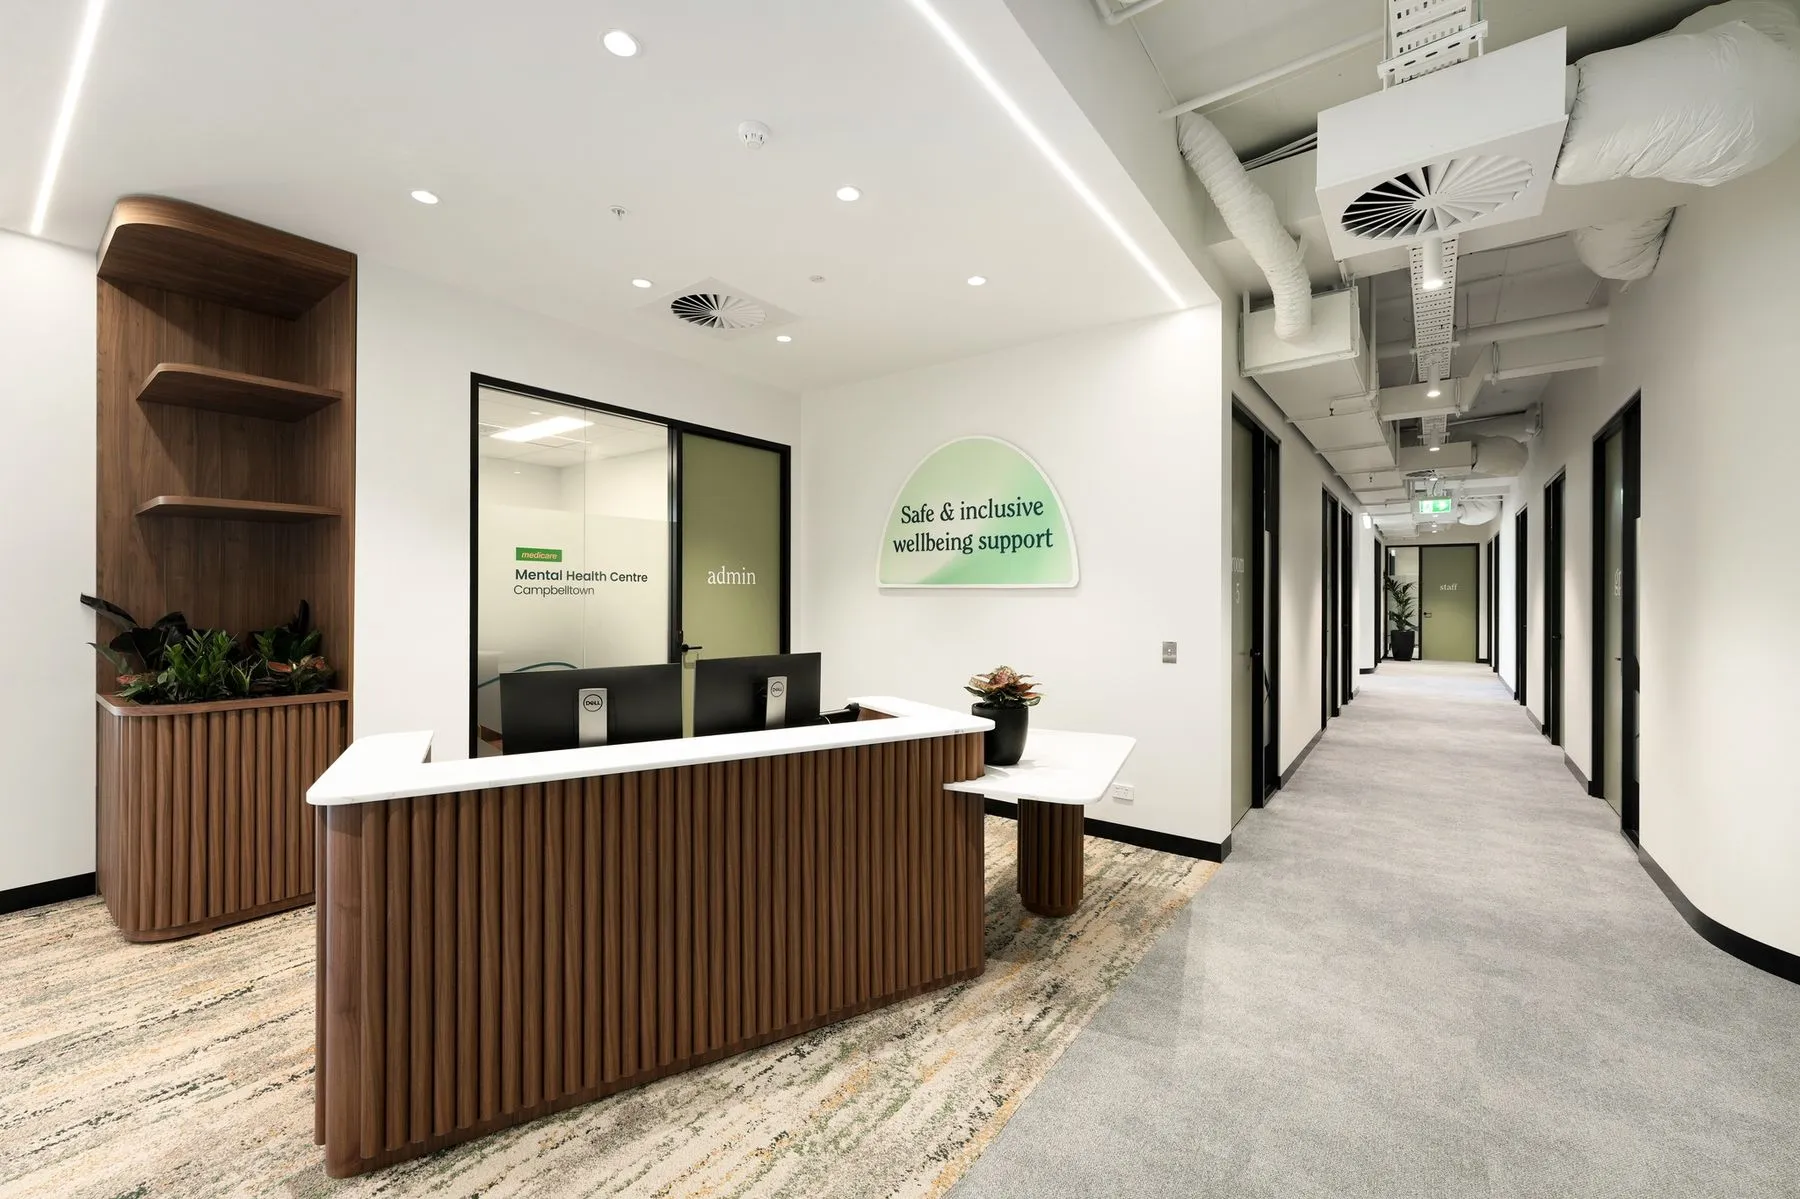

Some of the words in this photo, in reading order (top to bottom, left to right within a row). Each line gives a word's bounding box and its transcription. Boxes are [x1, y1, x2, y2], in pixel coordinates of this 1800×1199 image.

[901, 503, 934, 524] Safe
[940, 502, 954, 522] &
[960, 496, 1044, 520] inclusive
[893, 532, 974, 555] wellbeing
[978, 528, 1053, 554] support
[521, 550, 558, 560] medicare
[515, 569, 563, 581] Mental
[566, 570, 607, 582] Health
[610, 571, 648, 583] Centre
[707, 565, 756, 585] admin
[513, 584, 595, 598] Campbelltown
[1439, 582, 1458, 591] staff
